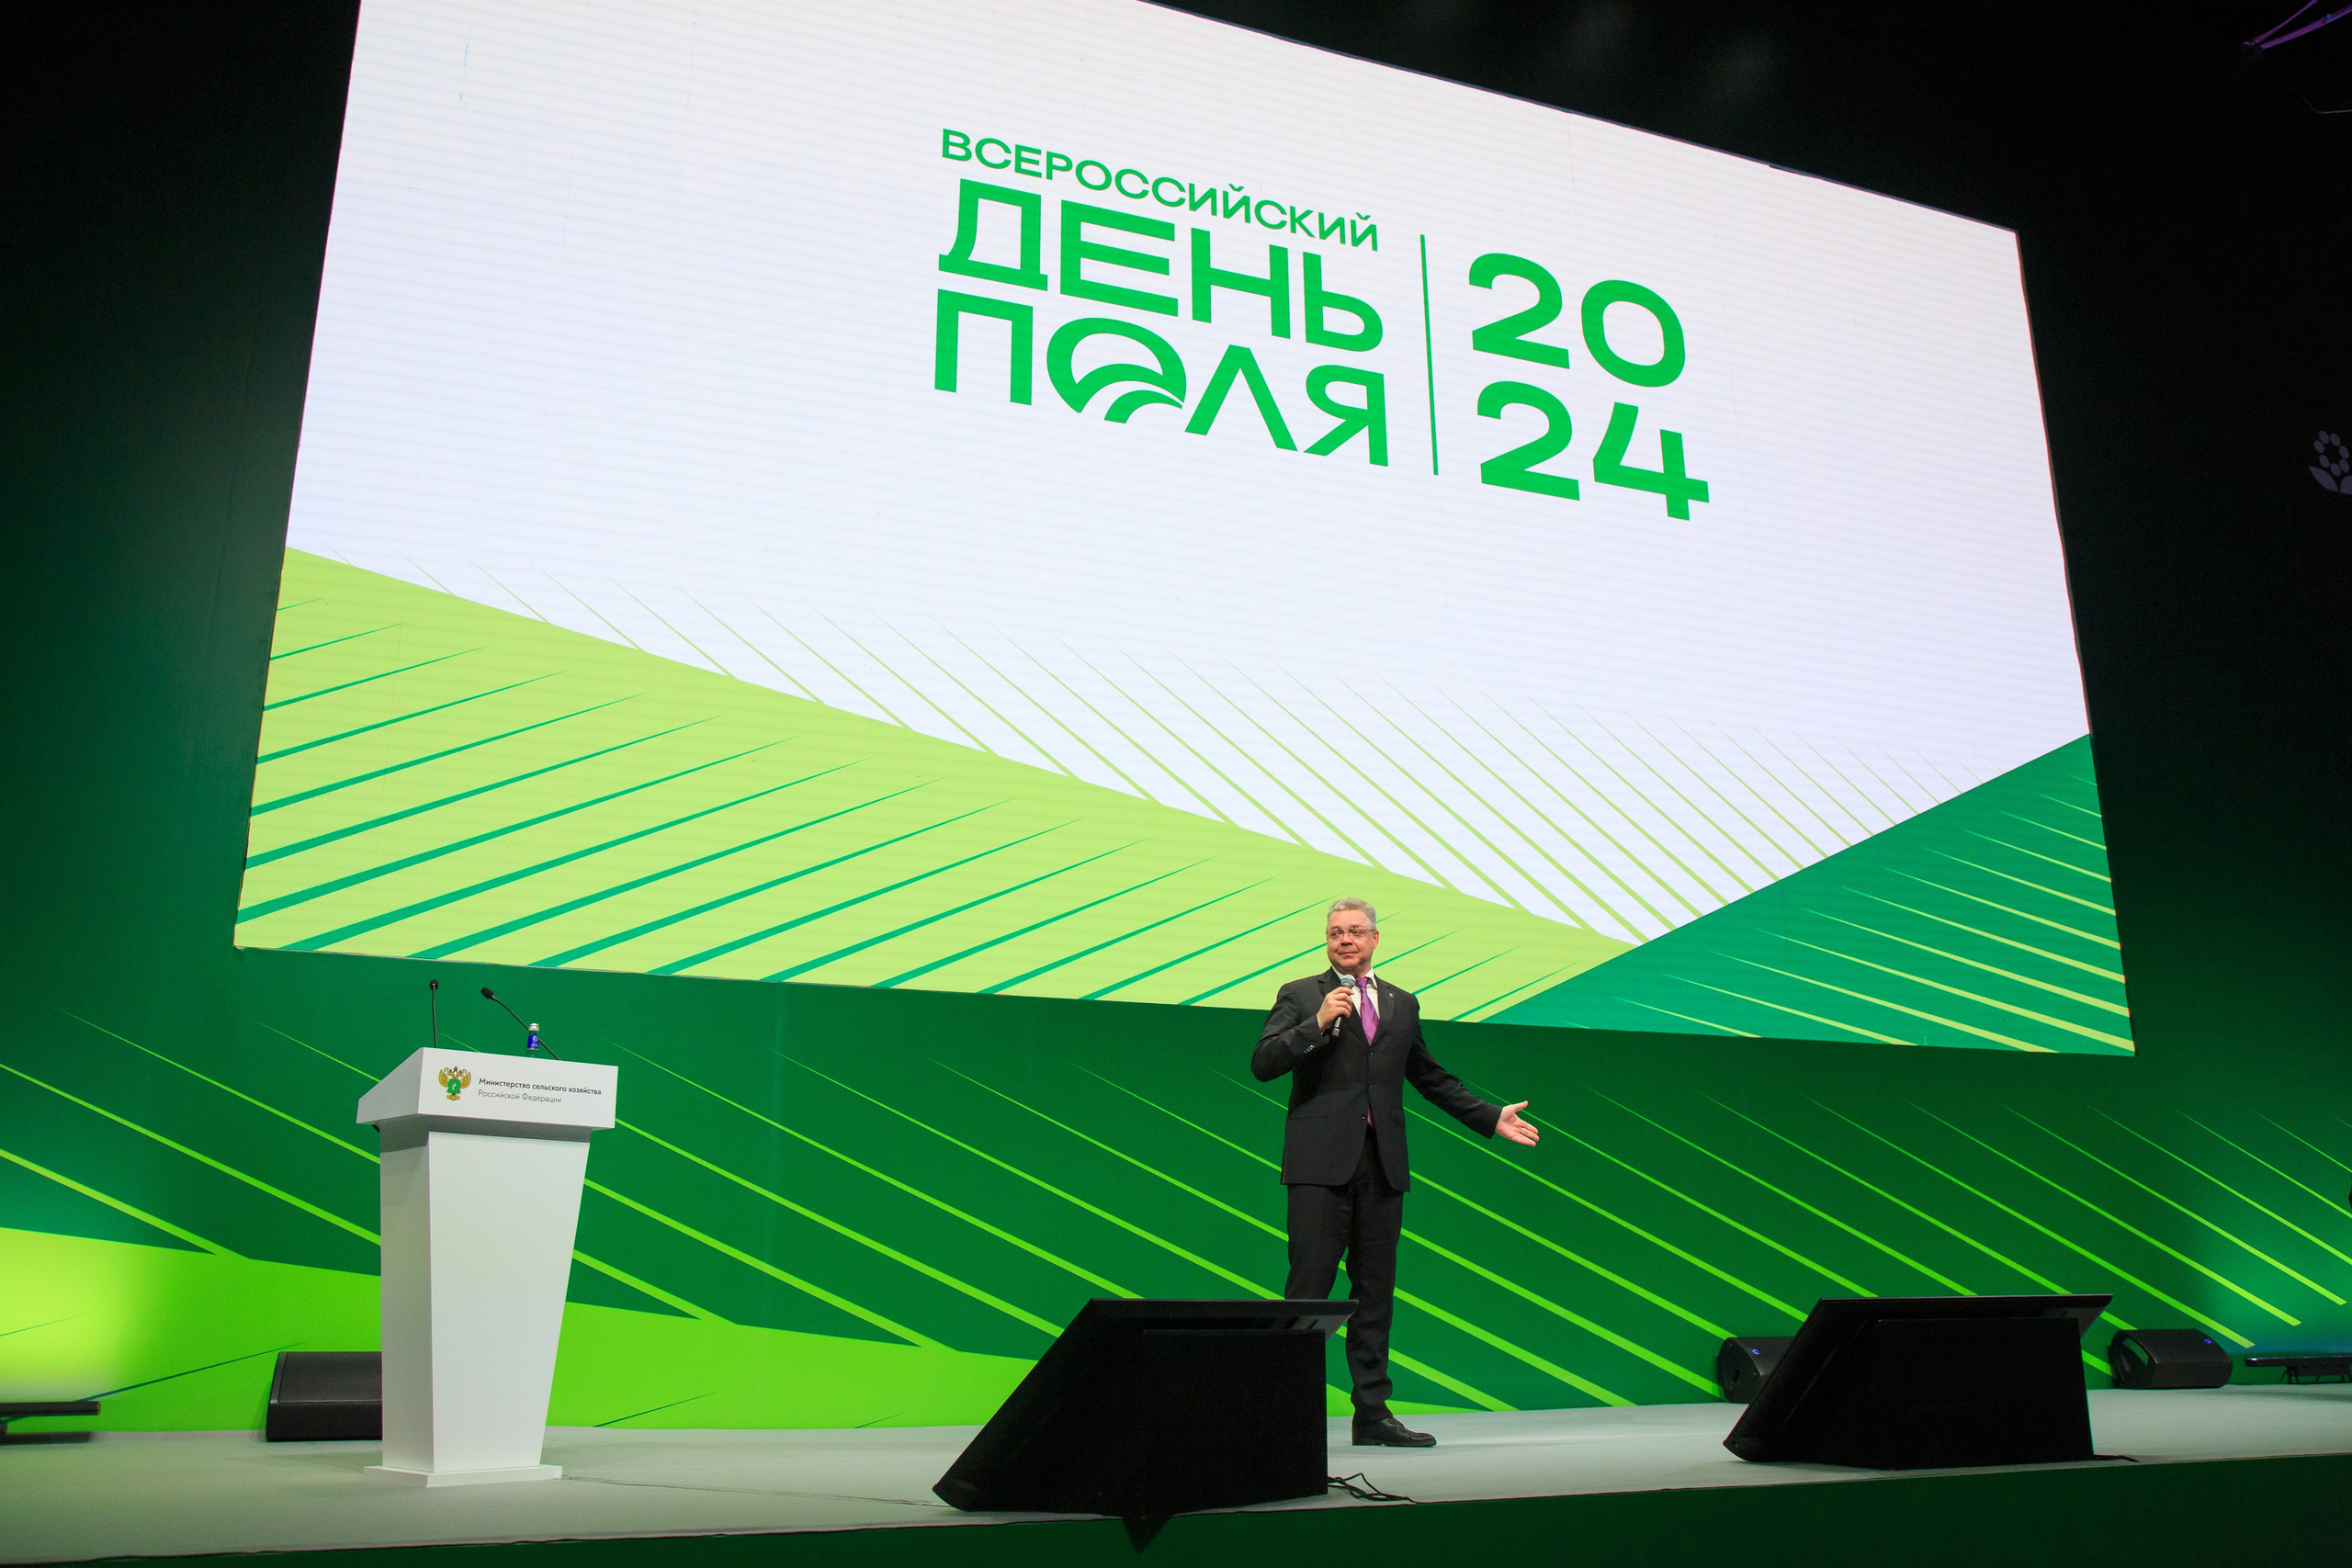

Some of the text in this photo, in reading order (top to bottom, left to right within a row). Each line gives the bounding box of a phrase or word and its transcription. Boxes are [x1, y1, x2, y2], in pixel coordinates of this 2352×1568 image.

[942, 127, 1378, 252] ВСЕРОССИЙСКИЙ
[938, 177, 1384, 352] ДЕНЬ
[1469, 252, 1687, 388] 20
[933, 288, 1389, 467] ПОЛЯ
[1477, 380, 1711, 521] 24
[478, 1077, 602, 1096] Министерство сельского хозяйства
[478, 1089, 562, 1103] Российской Федерации
